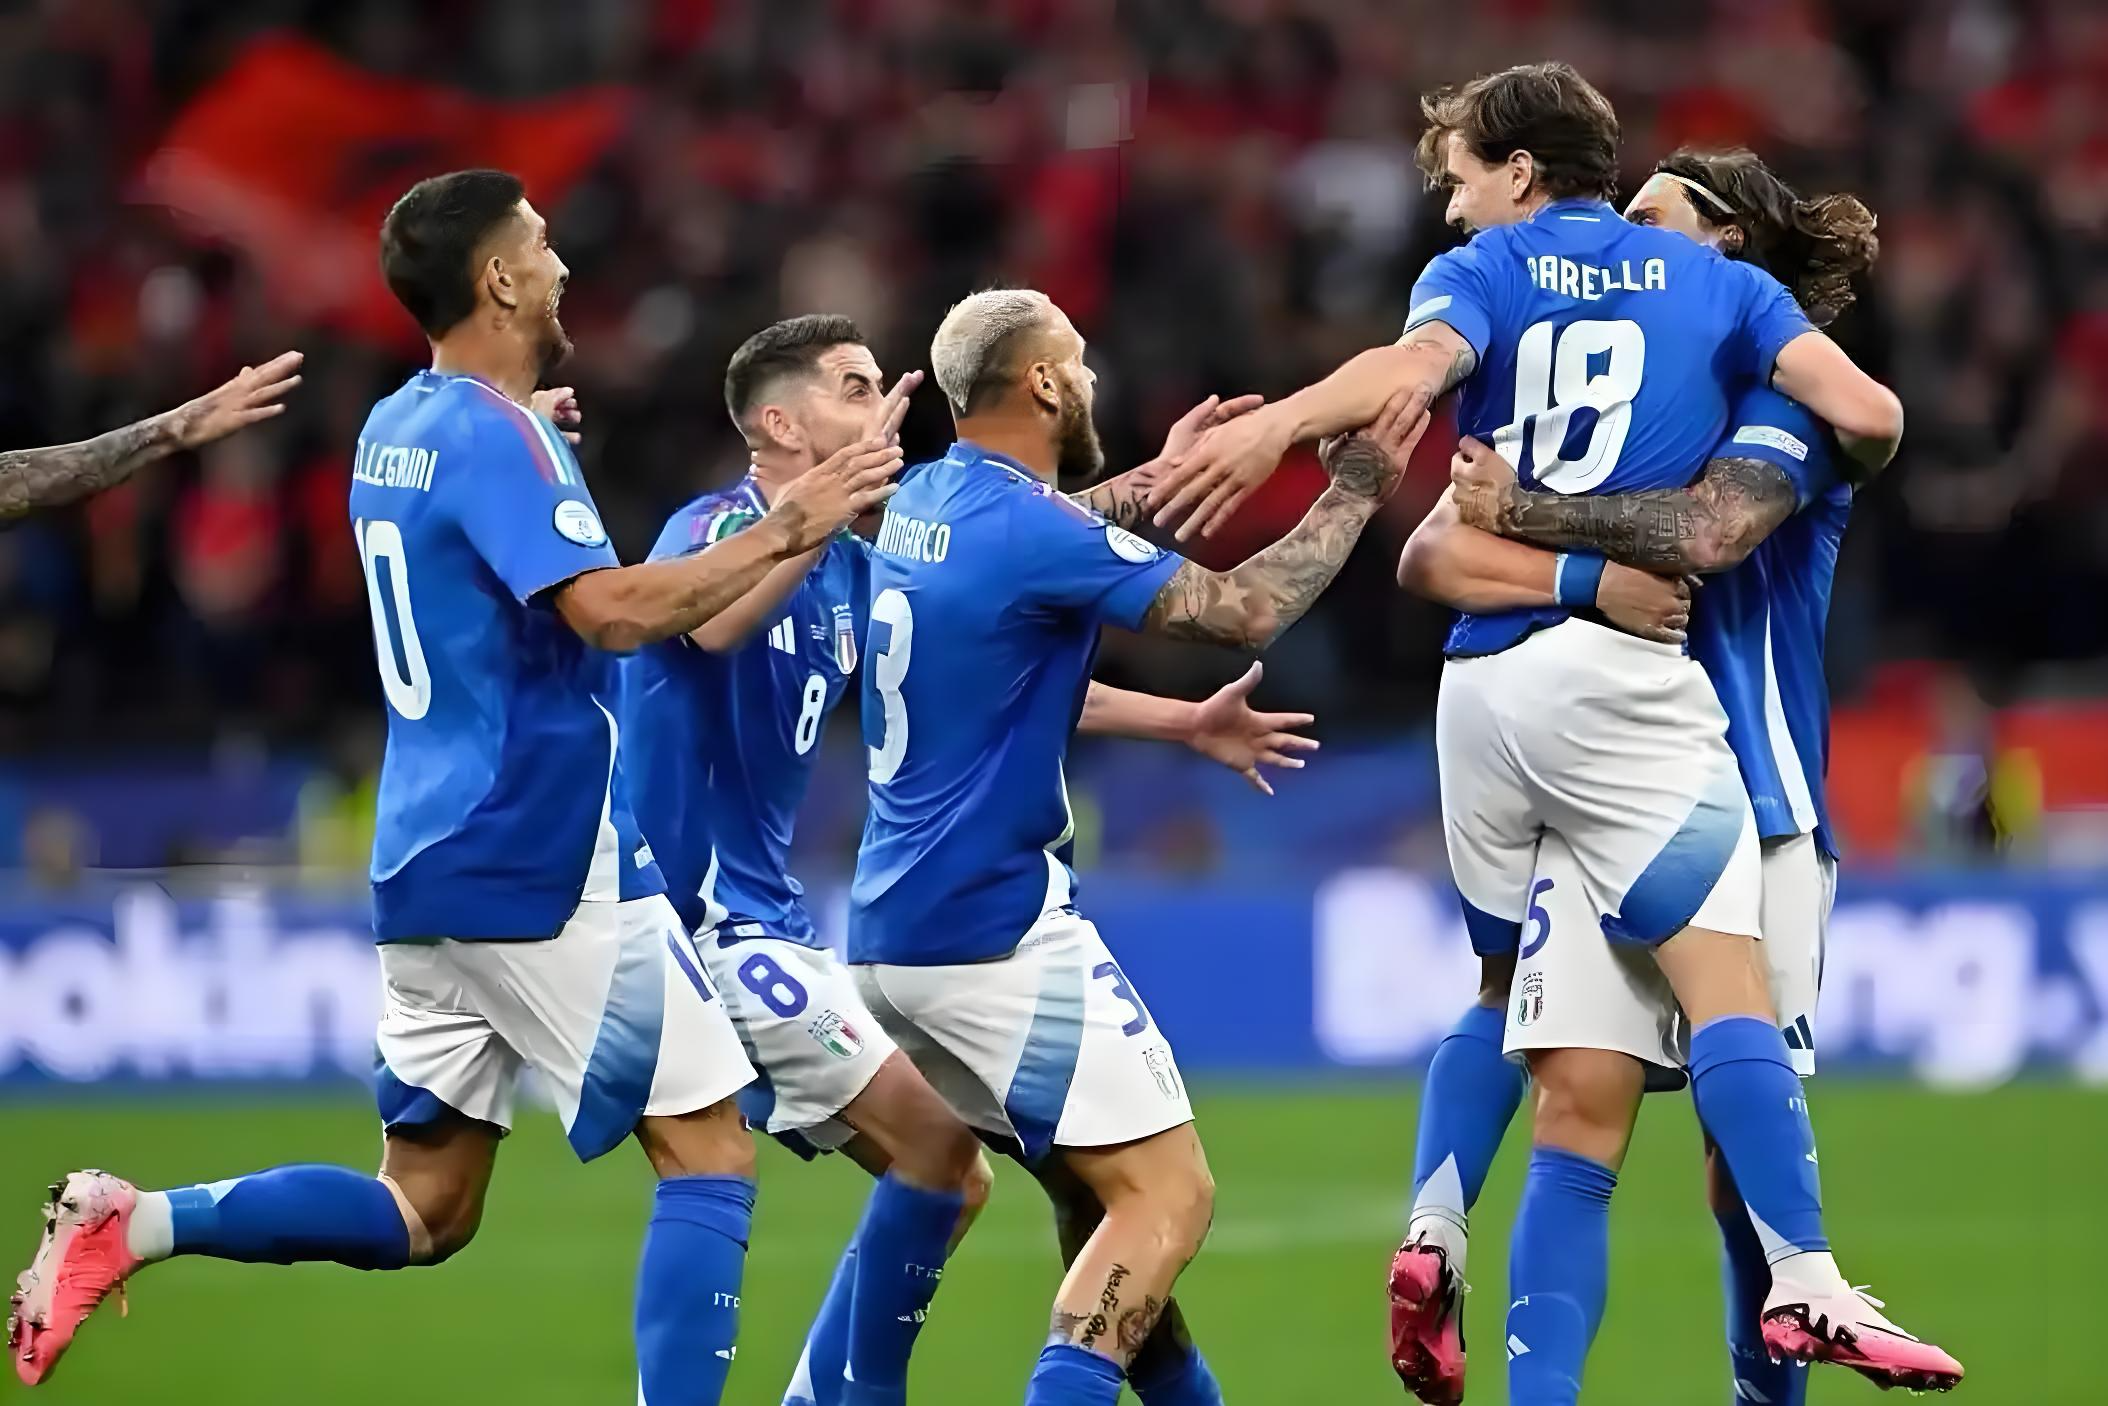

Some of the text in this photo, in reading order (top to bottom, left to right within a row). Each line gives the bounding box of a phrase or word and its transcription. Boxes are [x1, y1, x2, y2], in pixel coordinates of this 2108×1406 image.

[1493, 319, 1646, 495] 18
[354, 516, 432, 720] 0
[795, 674, 828, 756] 8
[868, 588, 913, 785] 3
[1520, 878, 1555, 961] 5
[737, 952, 809, 1019] 8
[1092, 961, 1149, 1038] 3
